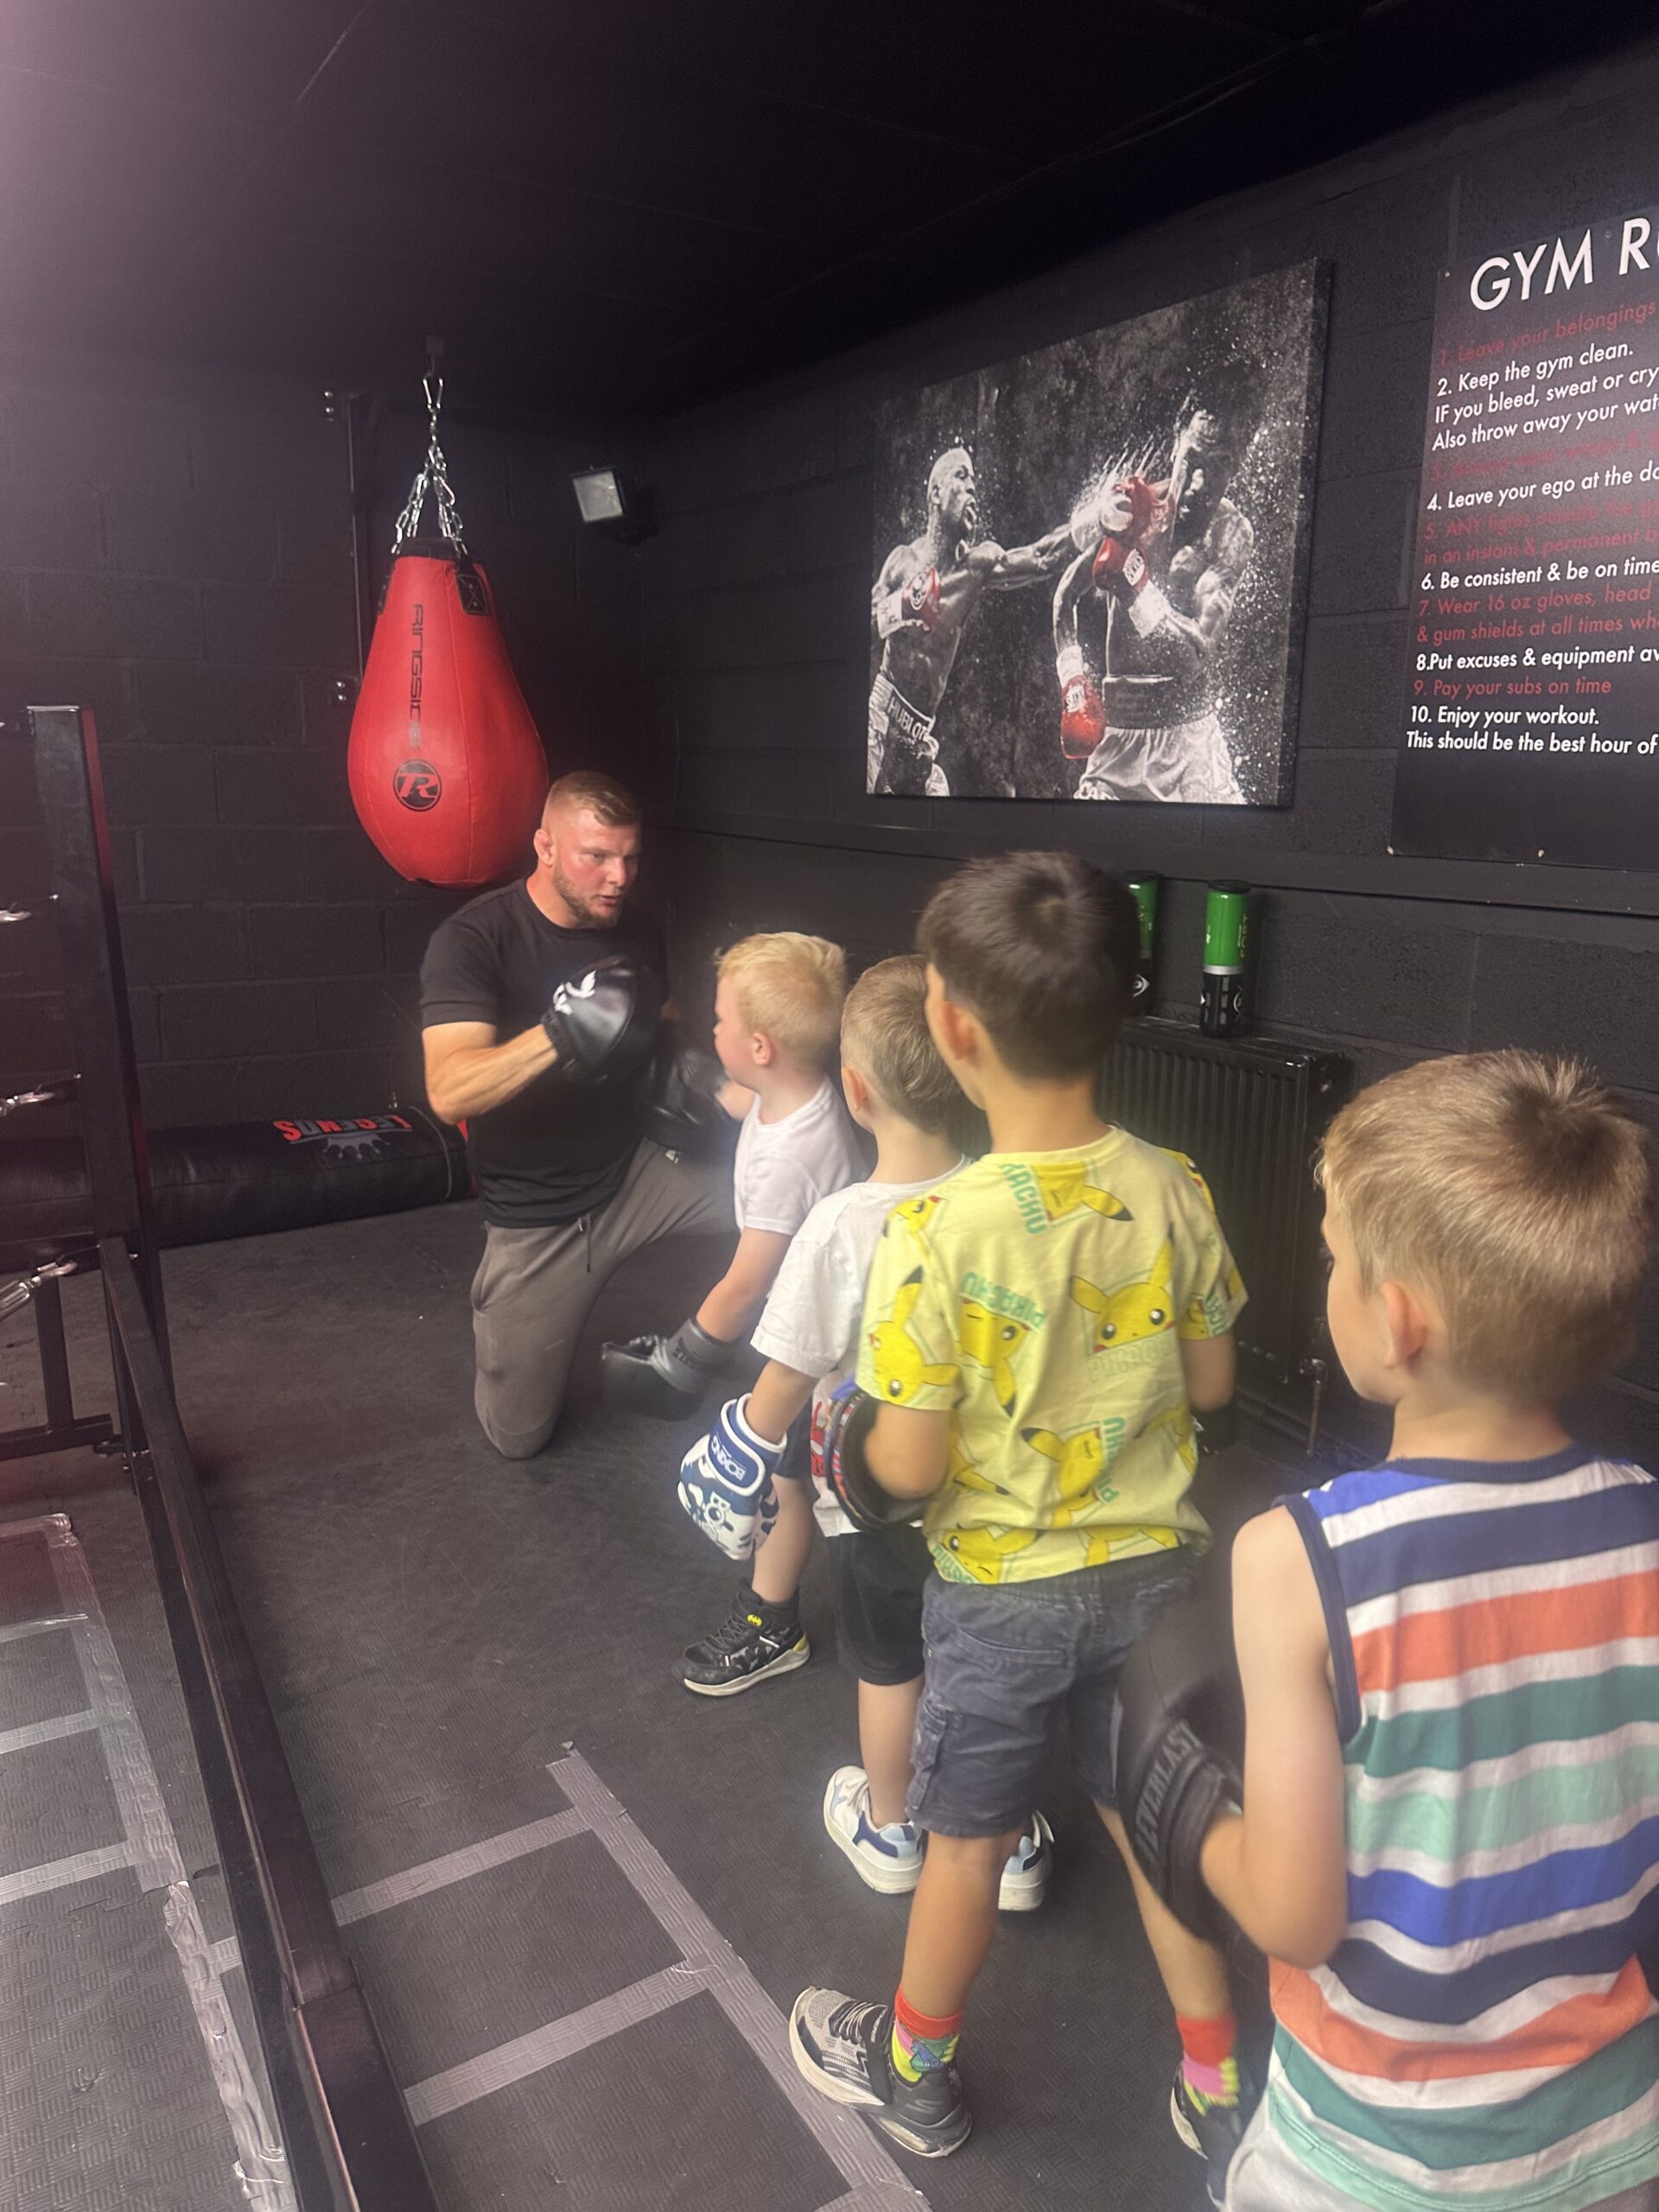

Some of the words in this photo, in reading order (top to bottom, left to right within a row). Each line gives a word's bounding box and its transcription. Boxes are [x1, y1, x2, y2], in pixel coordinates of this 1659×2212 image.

[1470, 229, 1593, 311] GYM
[1618, 218, 1659, 275] R
[1458, 340, 1504, 361] Leave
[1511, 327, 1549, 354] your
[1555, 302, 1656, 337] belongings
[1437, 378, 1452, 397] 2.
[1459, 372, 1499, 393] Keep
[1504, 360, 1530, 383] the
[1536, 354, 1573, 380] gym
[1580, 343, 1634, 366] clean.
[1435, 404, 1449, 423] IF
[1452, 400, 1483, 425] you
[1489, 385, 1540, 414] bleed,
[1546, 376, 1598, 402] sweat
[1602, 373, 1624, 391] or
[1629, 367, 1659, 387] cry
[1433, 430, 1465, 451] Also
[1471, 423, 1517, 444] throw
[1522, 412, 1571, 433] away
[1576, 404, 1618, 430] your
[1624, 393, 1659, 415] wat
[1427, 493, 1442, 511] 4.
[1448, 490, 1493, 509] Leave
[1497, 484, 1537, 507] your
[1541, 479, 1575, 499] ego
[1581, 472, 1600, 490] at
[1605, 465, 1633, 486] the
[1424, 549, 1436, 566] in
[1443, 549, 1460, 563] an
[1465, 540, 1518, 561] instant
[1523, 537, 1535, 556] &
[1541, 529, 1639, 558] permanent
[1421, 573, 1434, 591] 6.
[1440, 571, 1459, 589] Be
[1464, 564, 1542, 588] consistent
[1548, 562, 1560, 582] &
[1566, 560, 1589, 581] be
[1594, 563, 1618, 578] on
[1418, 599, 1431, 617] 7.
[1437, 598, 1480, 615] Wear
[1488, 594, 1504, 612] 16
[1510, 594, 1531, 611] oz
[1537, 588, 1597, 613] gloves,
[1605, 581, 1652, 603] head
[1416, 627, 1428, 643] &
[1433, 626, 1465, 645] gum
[1471, 620, 1524, 640] shields
[1529, 618, 1547, 636] at
[1552, 614, 1572, 635] all
[1579, 613, 1624, 633] times
[1630, 609, 1659, 630] wh
[1416, 652, 1453, 671] 8.Put
[1457, 648, 1517, 669] excuses
[1522, 648, 1535, 666] &
[1541, 645, 1635, 671] equipment
[1414, 680, 1427, 697] 9.
[1433, 679, 1460, 700] Pay
[1466, 680, 1502, 700] your
[1507, 676, 1541, 695] subs
[1548, 679, 1569, 694] on
[1575, 676, 1611, 694] time
[887, 696, 927, 741] HUBLOT
[1410, 705, 1432, 723] 10.
[1438, 706, 1479, 728] Enjoy
[1484, 709, 1522, 728] your
[1526, 704, 1599, 725] workout.
[1407, 730, 1434, 749] This
[1437, 731, 1488, 751] should
[1492, 731, 1513, 751] be
[1518, 732, 1544, 752] the
[1549, 732, 1585, 753] best
[1590, 733, 1632, 754] hour
[1637, 734, 1658, 754] of
